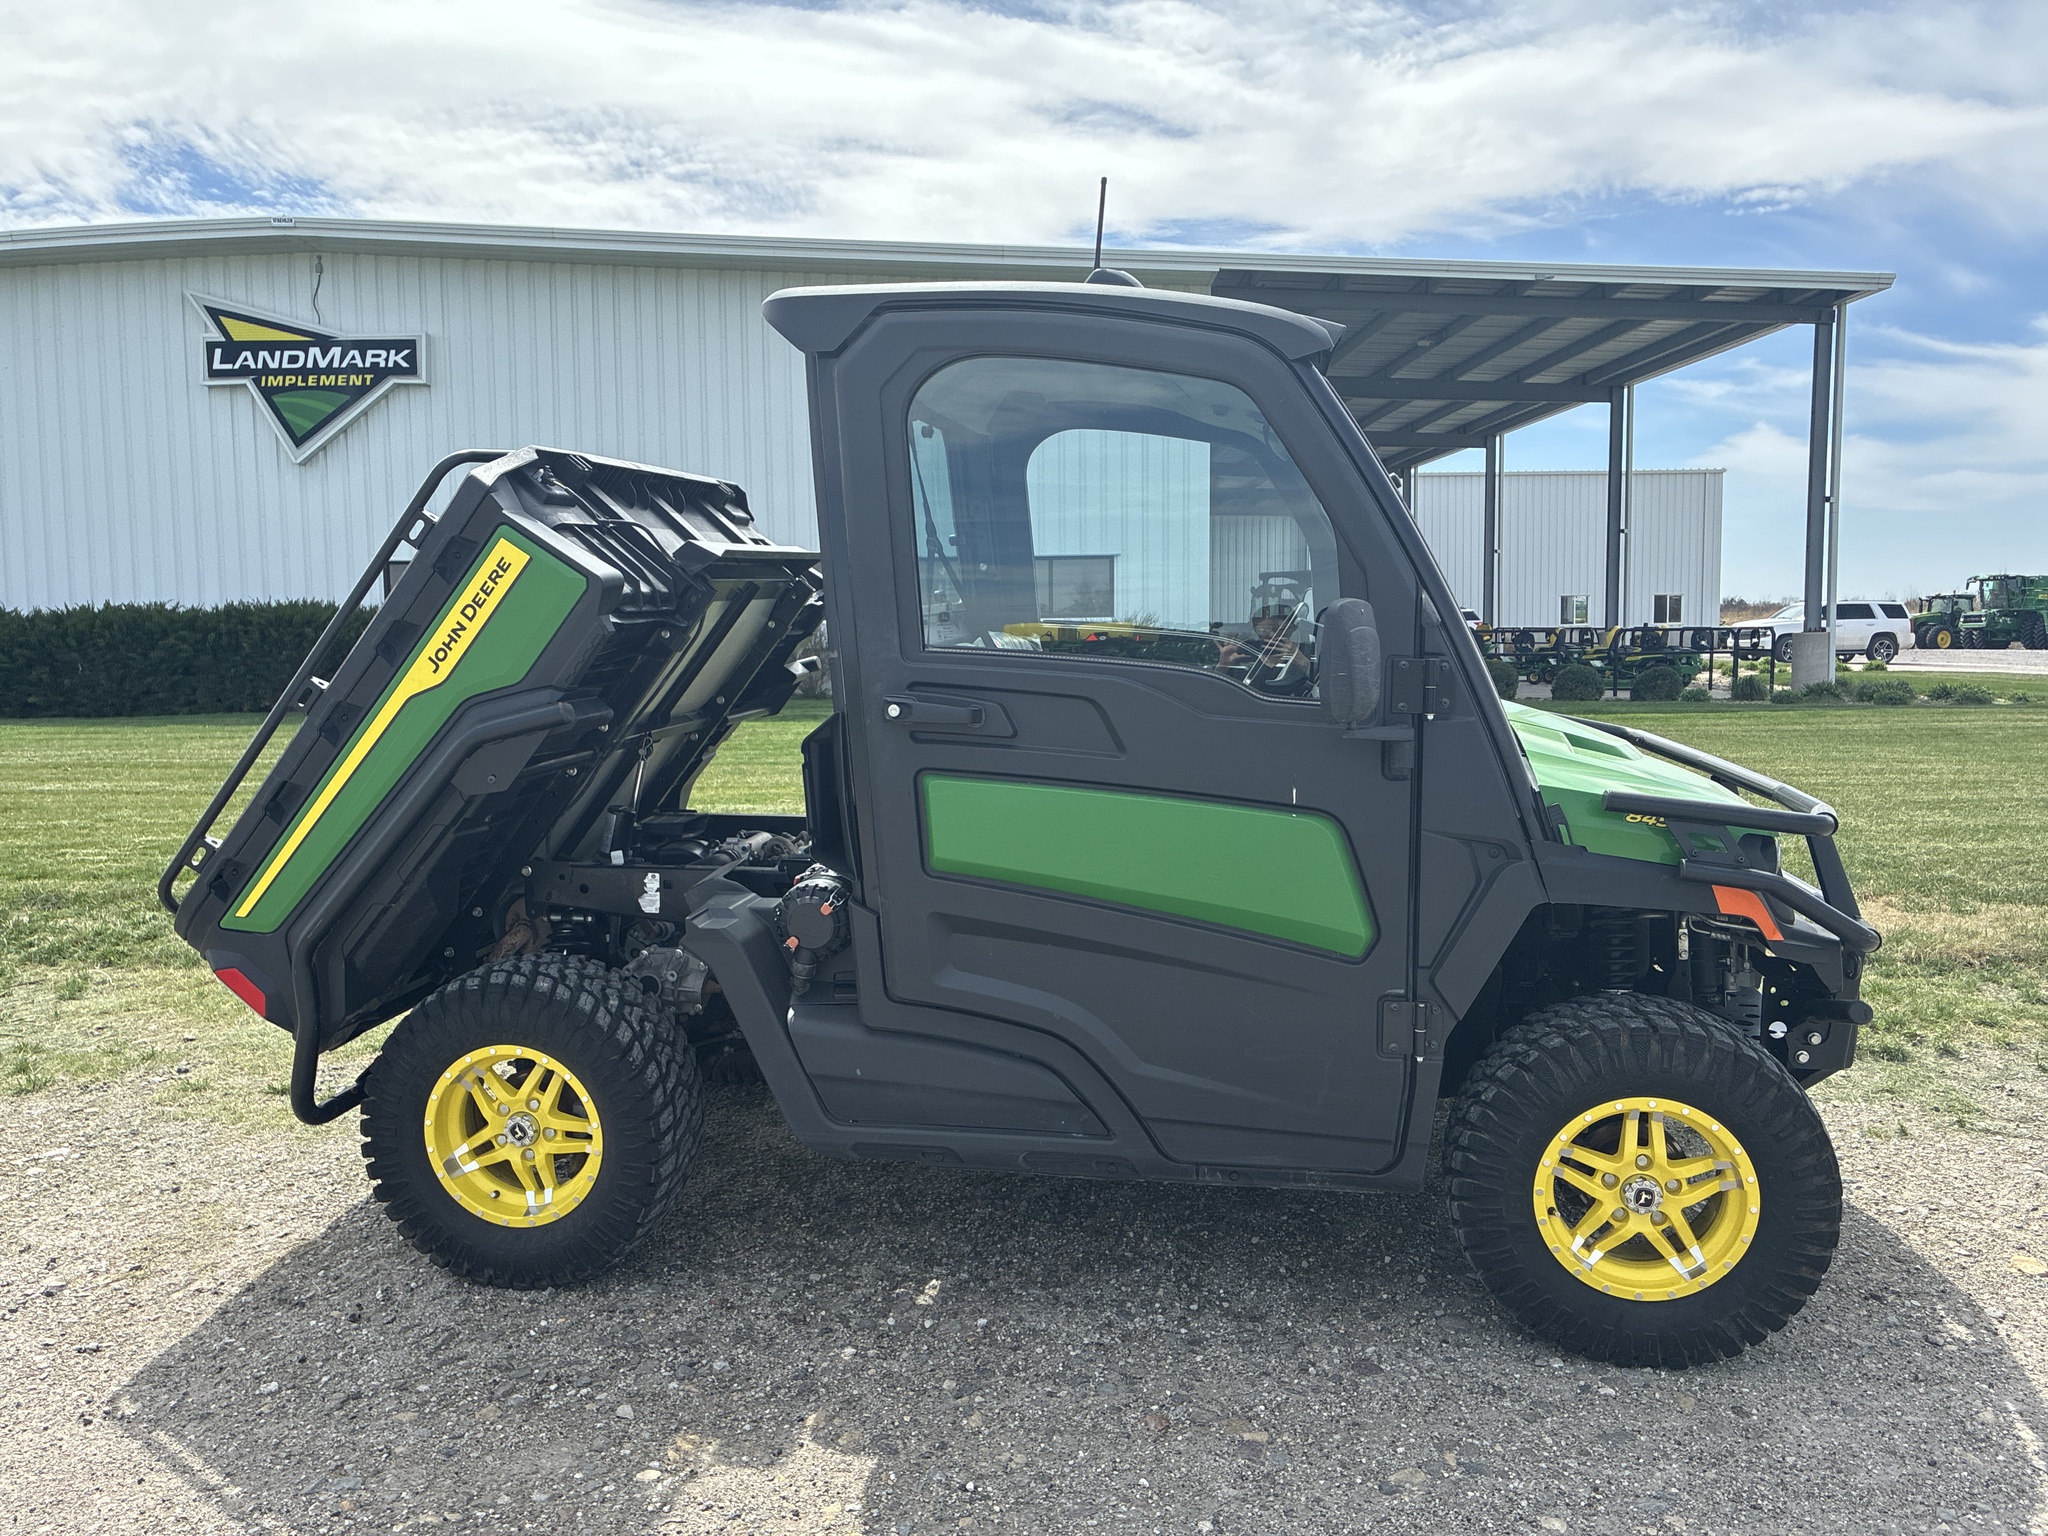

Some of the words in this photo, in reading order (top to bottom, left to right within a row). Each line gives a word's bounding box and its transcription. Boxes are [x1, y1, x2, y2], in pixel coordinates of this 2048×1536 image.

[261, 374, 374, 387] IMPLEMENT
[427, 621, 467, 674] JOHN
[459, 556, 512, 622] DEERE
